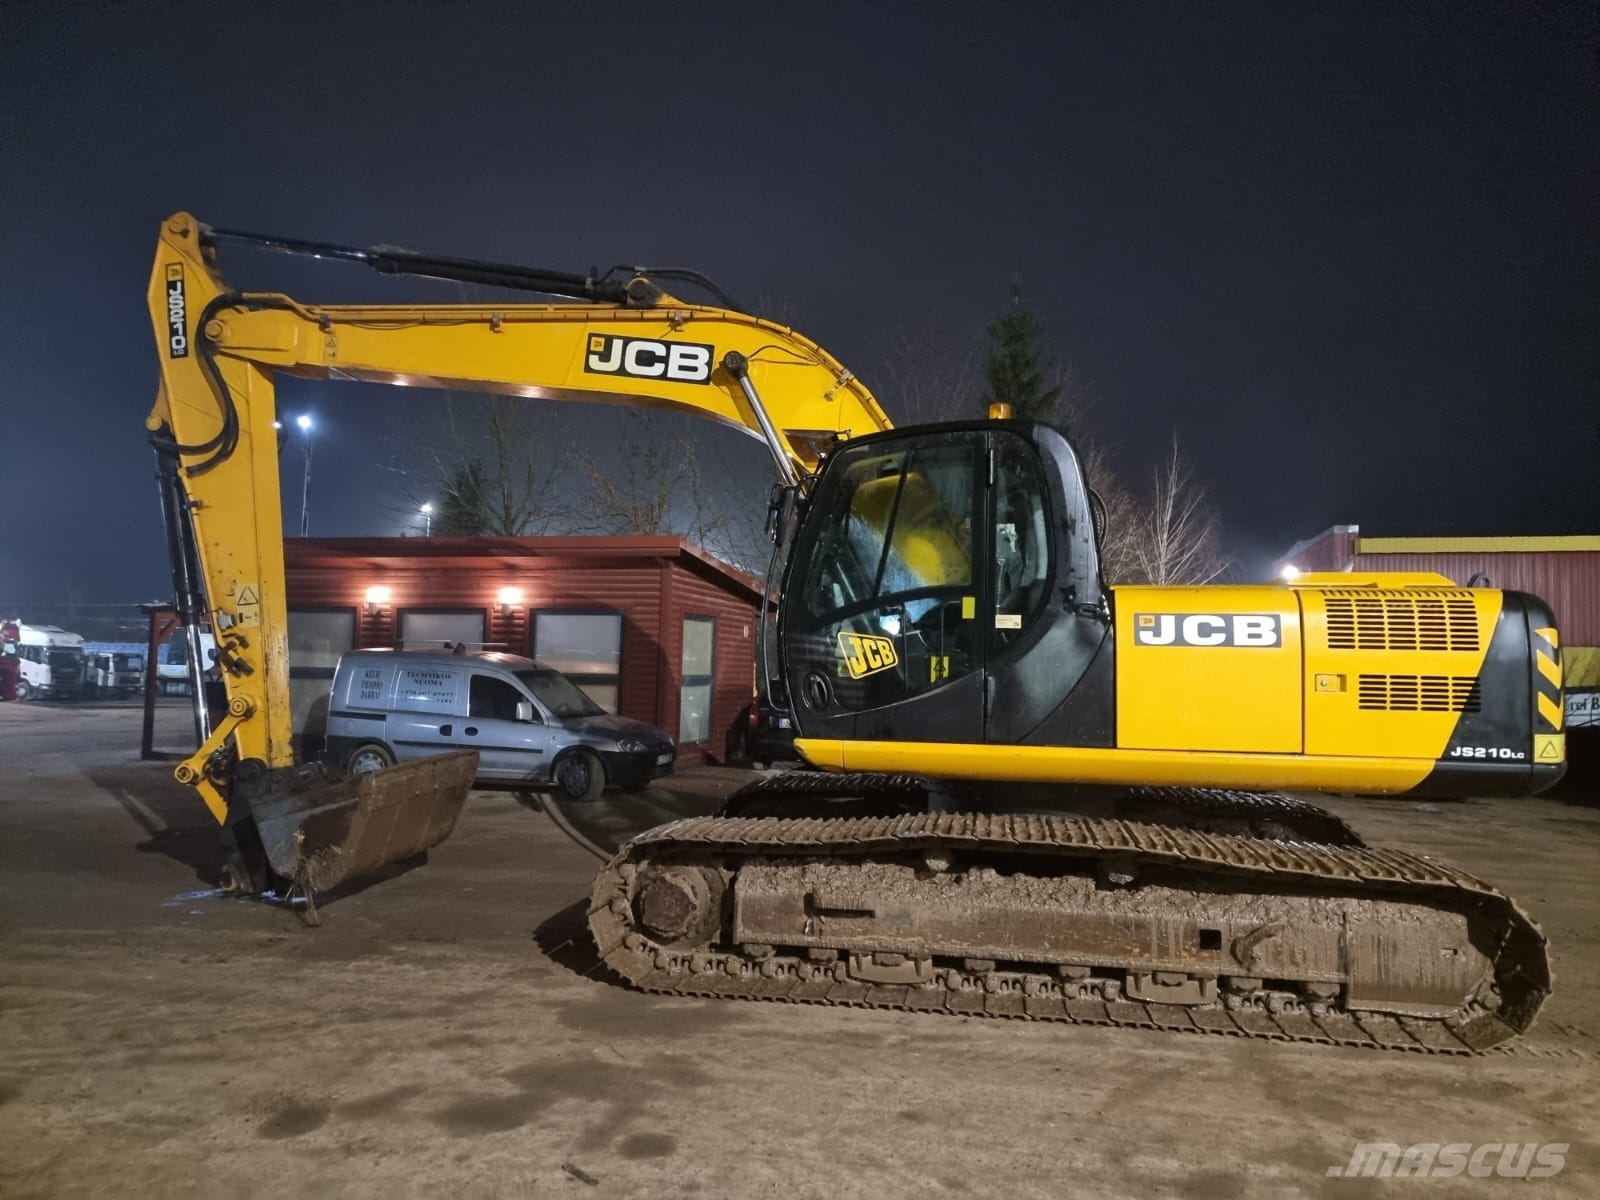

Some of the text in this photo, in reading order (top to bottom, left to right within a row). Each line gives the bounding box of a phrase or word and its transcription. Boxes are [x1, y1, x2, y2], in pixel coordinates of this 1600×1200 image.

[588, 338, 710, 381] JCB
[1139, 614, 1278, 646] JCB
[849, 637, 894, 674] JCB
[1450, 746, 1525, 759] JS210LC
